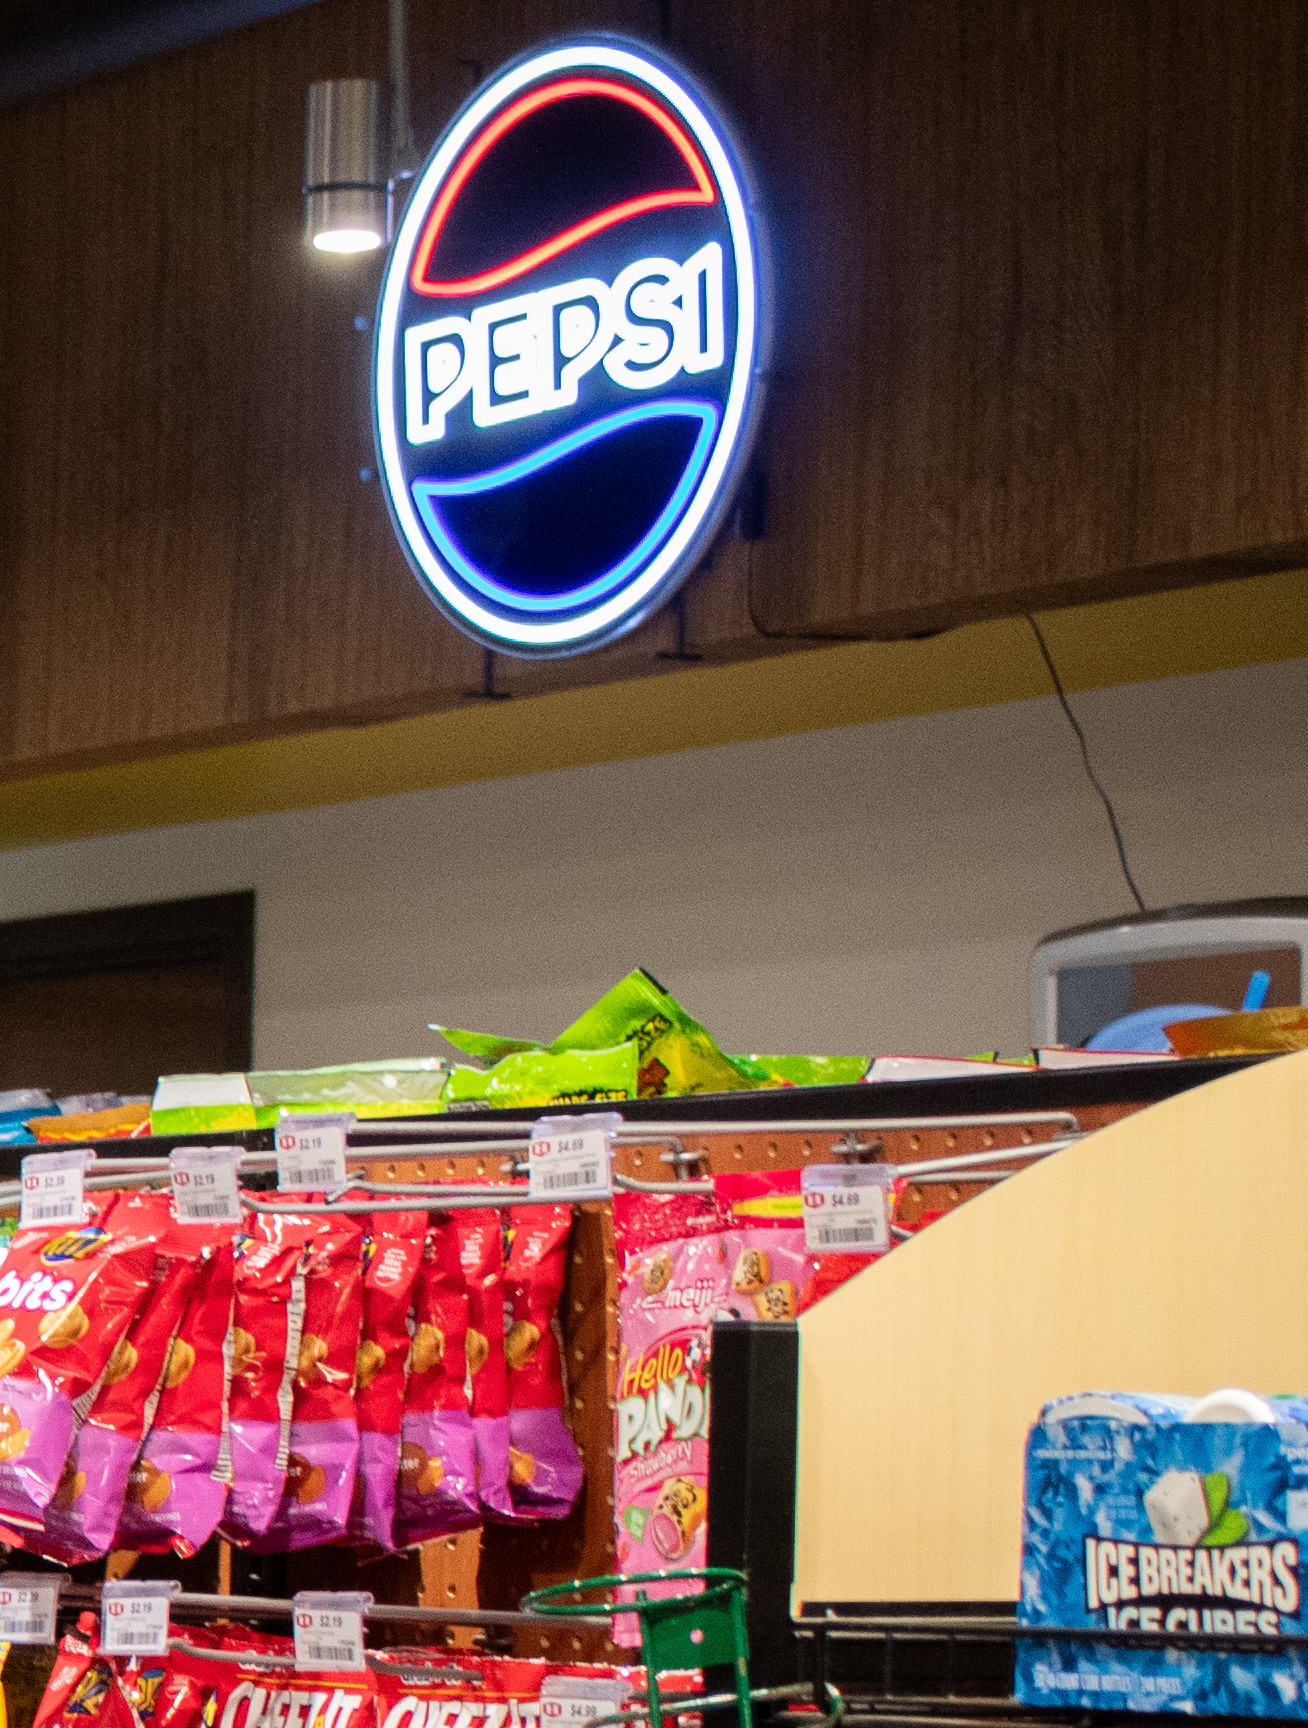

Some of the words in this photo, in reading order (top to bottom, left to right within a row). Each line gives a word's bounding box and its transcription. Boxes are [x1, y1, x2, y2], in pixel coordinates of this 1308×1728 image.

[403, 241, 723, 445] PEPSI
[624, 1347, 683, 1390] Hello
[617, 1372, 709, 1464] PAND
[1086, 1537, 1138, 1609] ICE
[1137, 1539, 1299, 1614] BREAKERS
